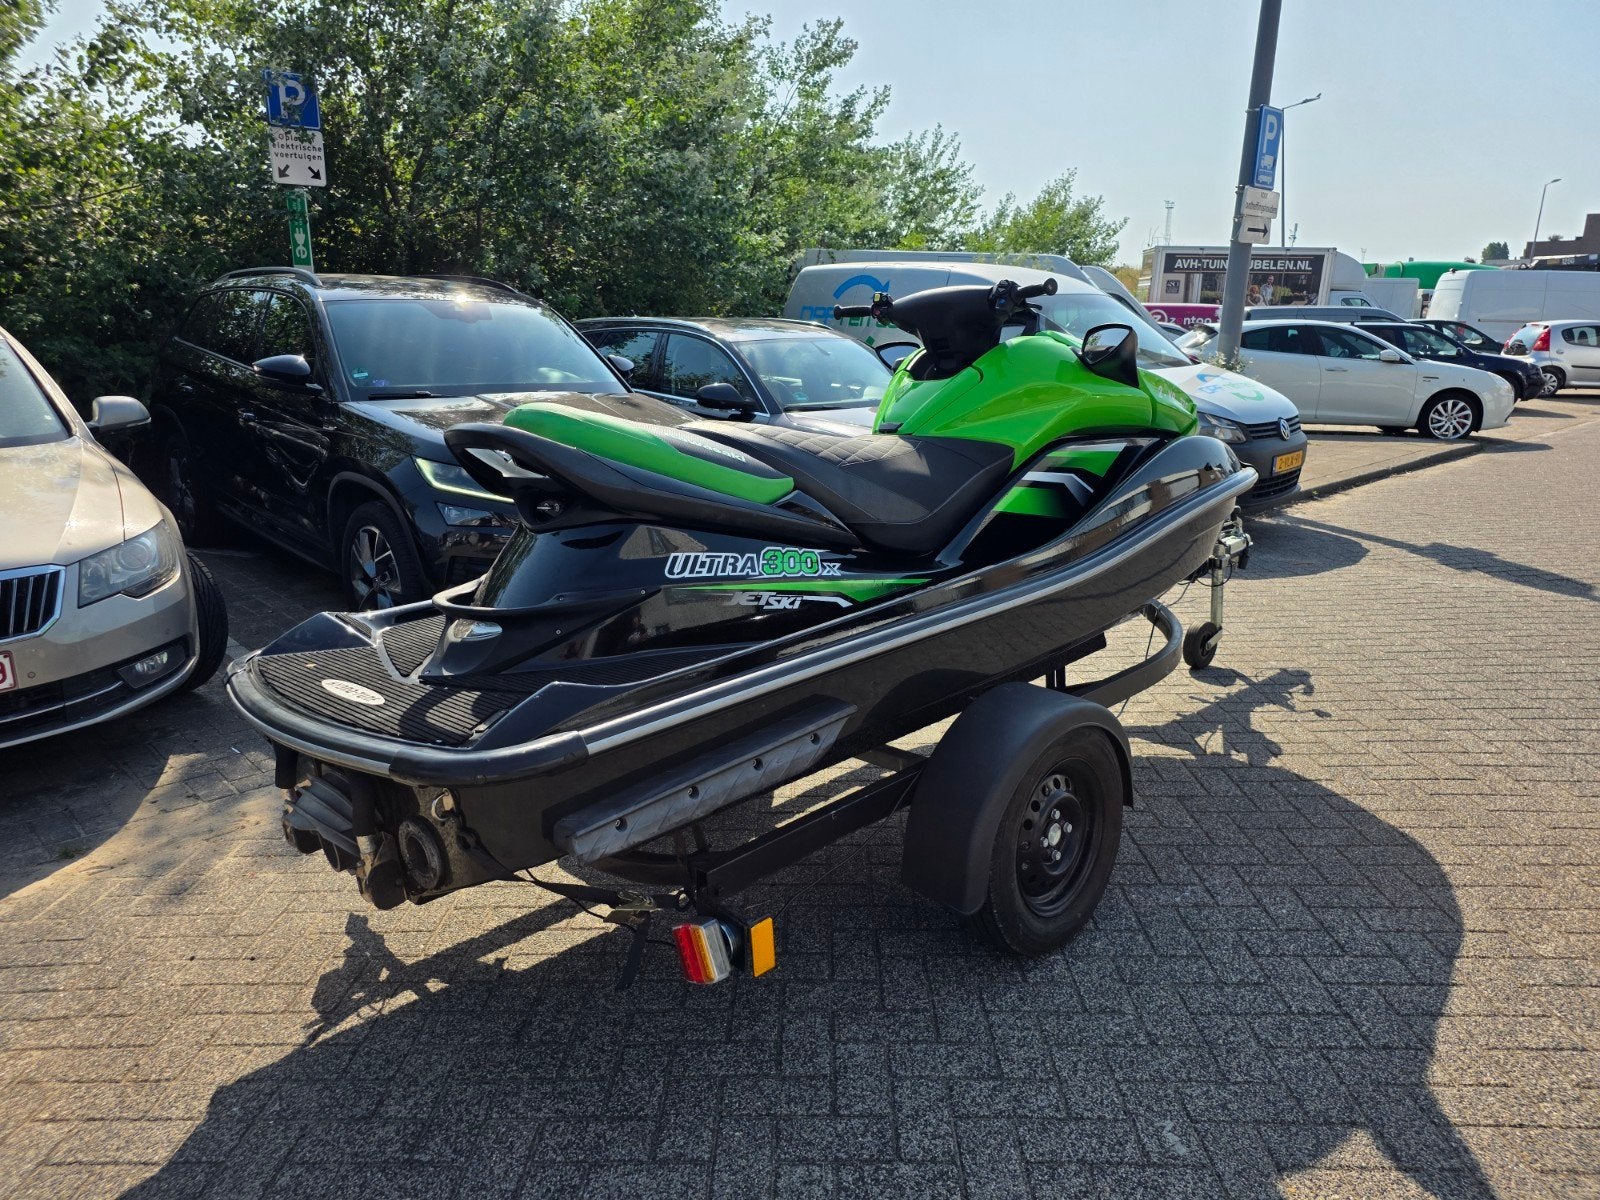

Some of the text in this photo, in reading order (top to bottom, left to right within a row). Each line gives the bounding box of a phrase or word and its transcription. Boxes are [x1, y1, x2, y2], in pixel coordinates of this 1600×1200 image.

[279, 80, 306, 119] P
[272, 142, 322, 152] elektrische
[1262, 114, 1277, 153] P
[274, 152, 322, 161] voertuigen
[665, 552, 759, 579] ULTRA
